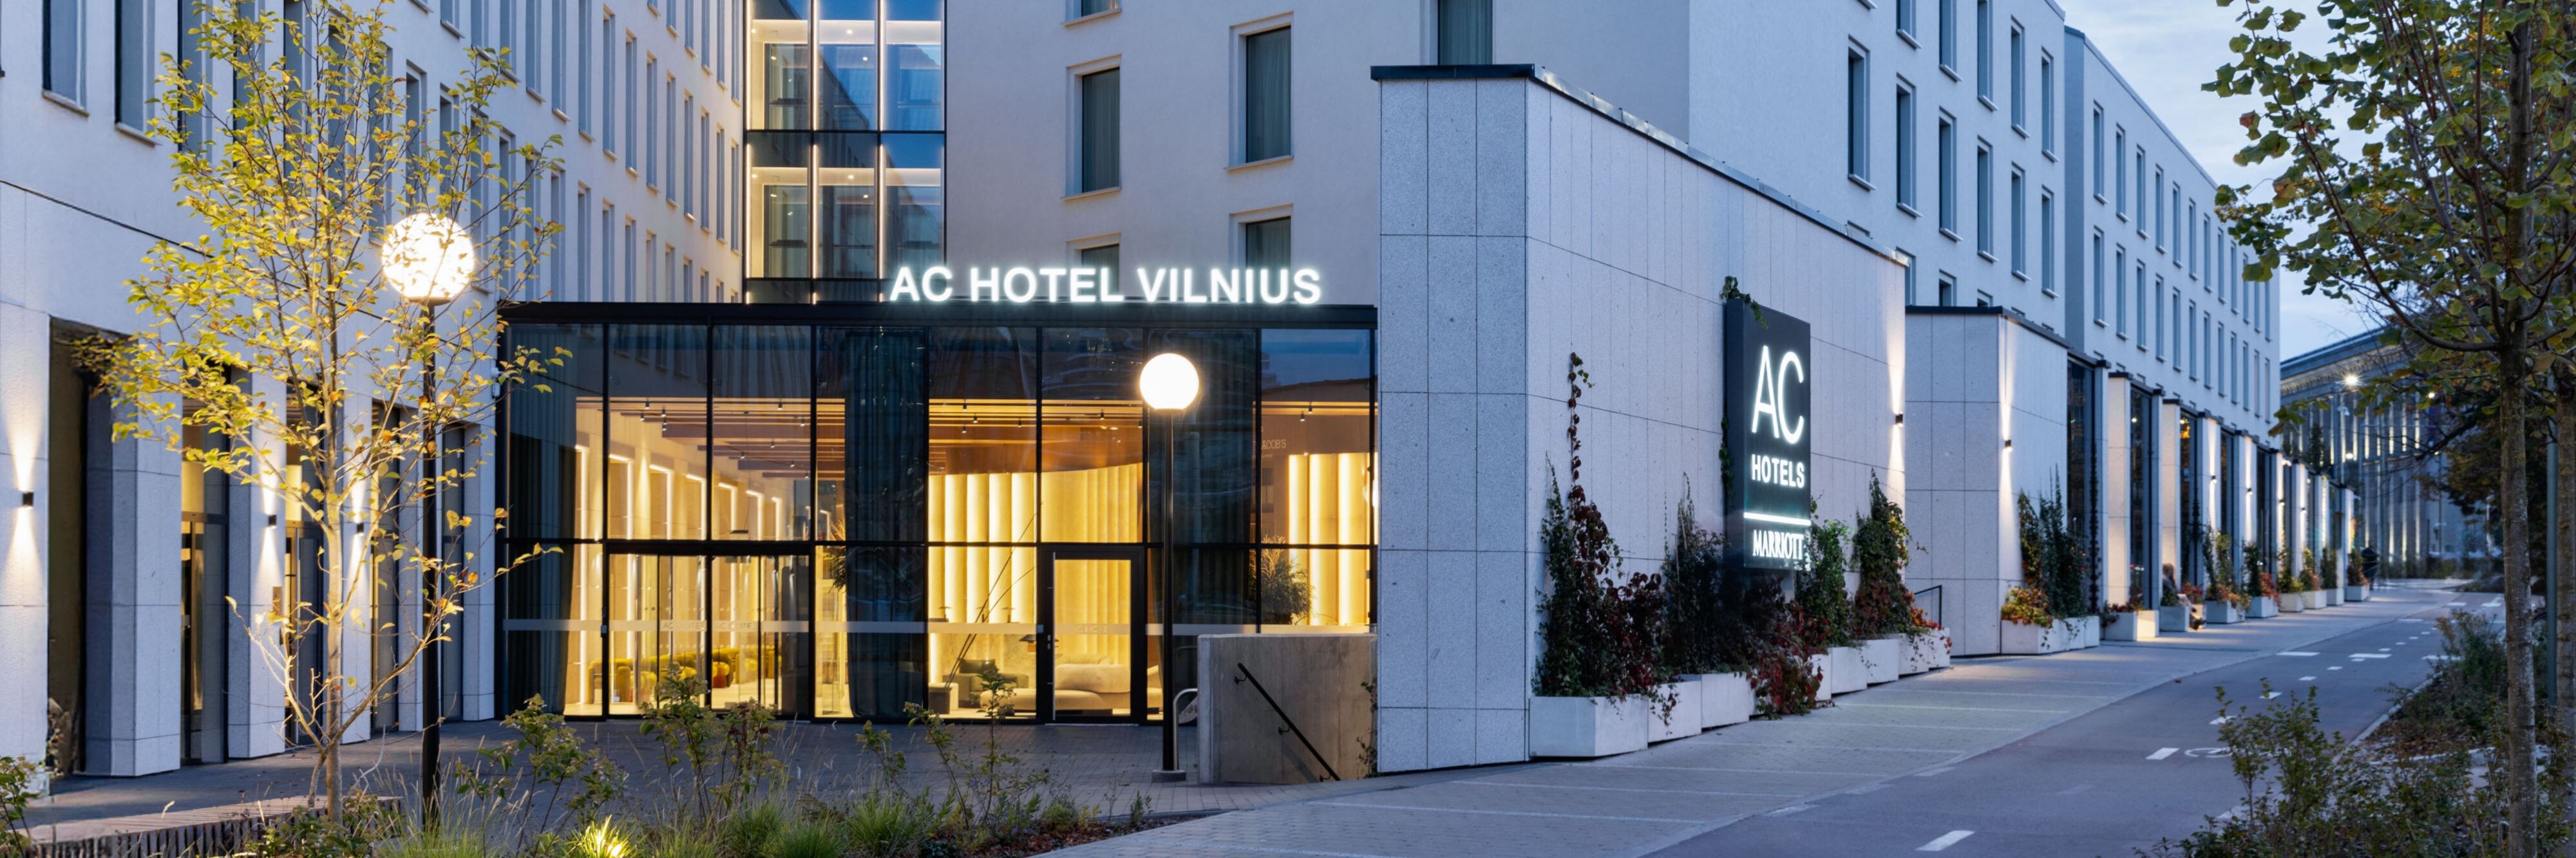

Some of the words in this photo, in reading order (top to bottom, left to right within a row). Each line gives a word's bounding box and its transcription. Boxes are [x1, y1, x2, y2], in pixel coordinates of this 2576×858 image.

[889, 266, 952, 302] AC
[970, 266, 1124, 303] HOTEL
[1137, 267, 1321, 304] VILNIUS
[1752, 346, 1804, 443] AC
[1261, 438, 1287, 450] ACOB'S
[1752, 454, 1804, 488] HOTELS
[1752, 530, 1804, 560] MARRIOTT
